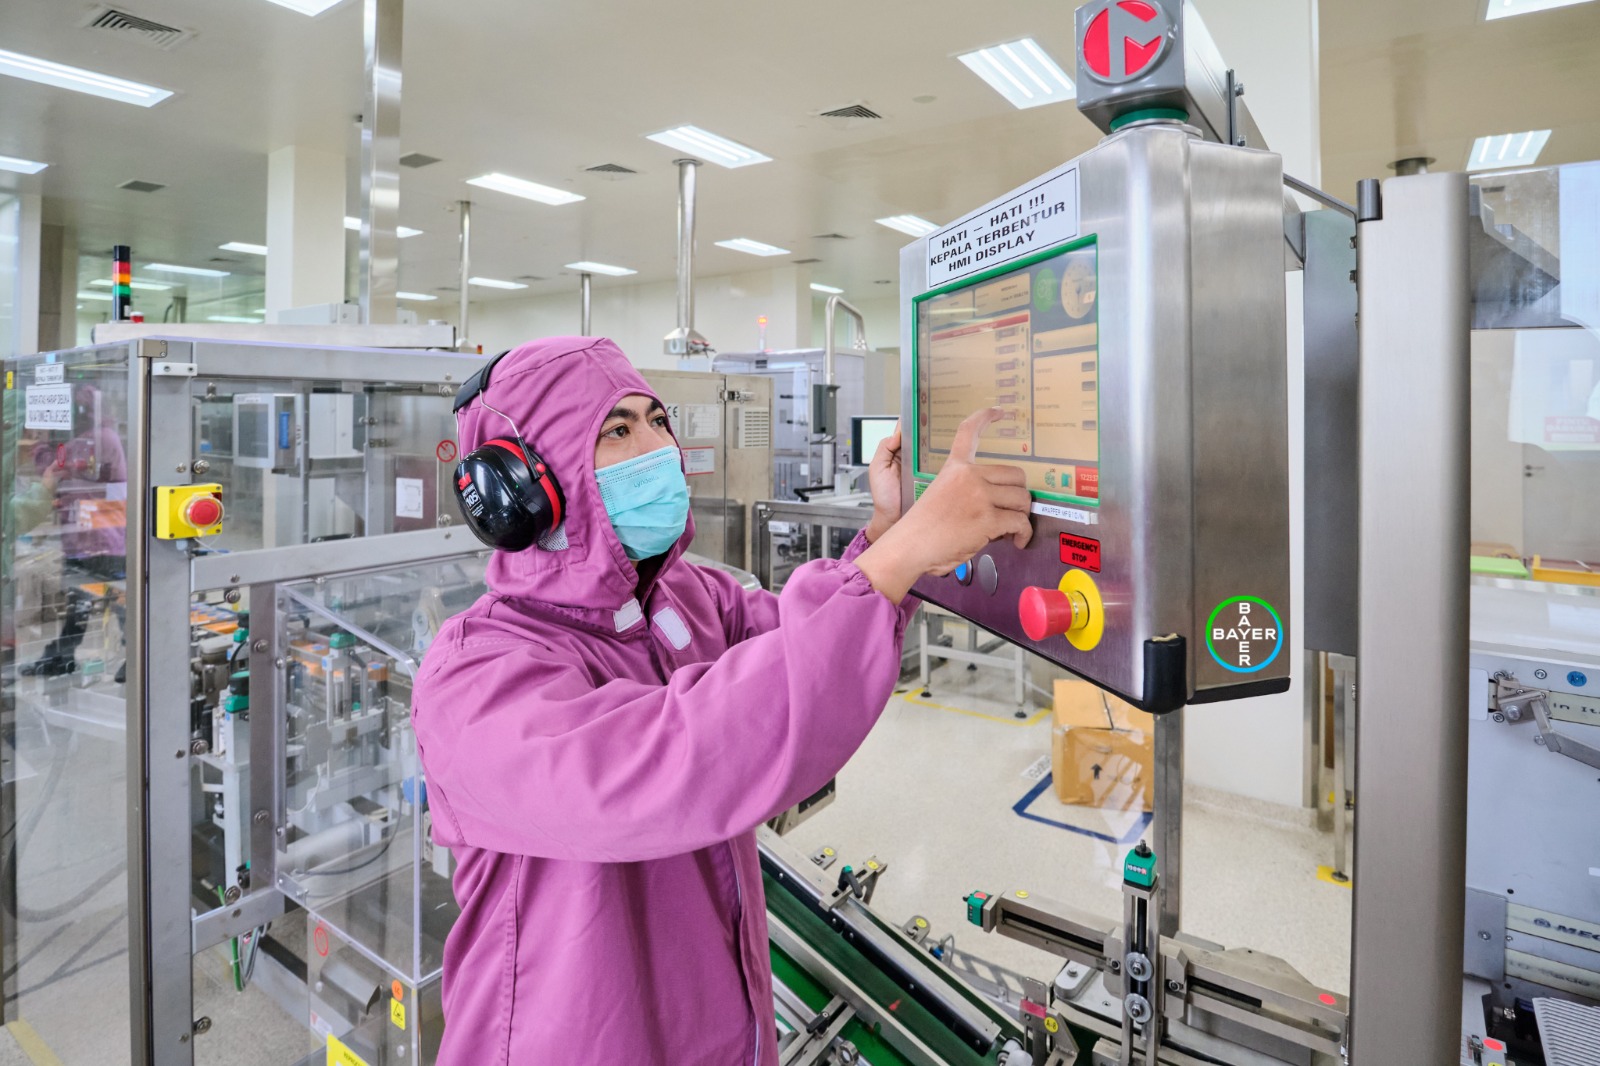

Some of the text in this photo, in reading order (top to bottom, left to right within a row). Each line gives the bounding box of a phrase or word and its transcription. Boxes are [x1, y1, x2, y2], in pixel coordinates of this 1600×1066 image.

[942, 230, 967, 249] HATI
[990, 204, 1022, 227] HATI
[1029, 193, 1046, 209] !!!
[930, 201, 1066, 266] KEPALA TERBENTUR
[948, 230, 1035, 272] HMI DISPLAY
[458, 472, 472, 491] 3M
[464, 491, 480, 508] 105
[1062, 537, 1098, 553] EMERGENCY
[1072, 552, 1087, 563] STOP
